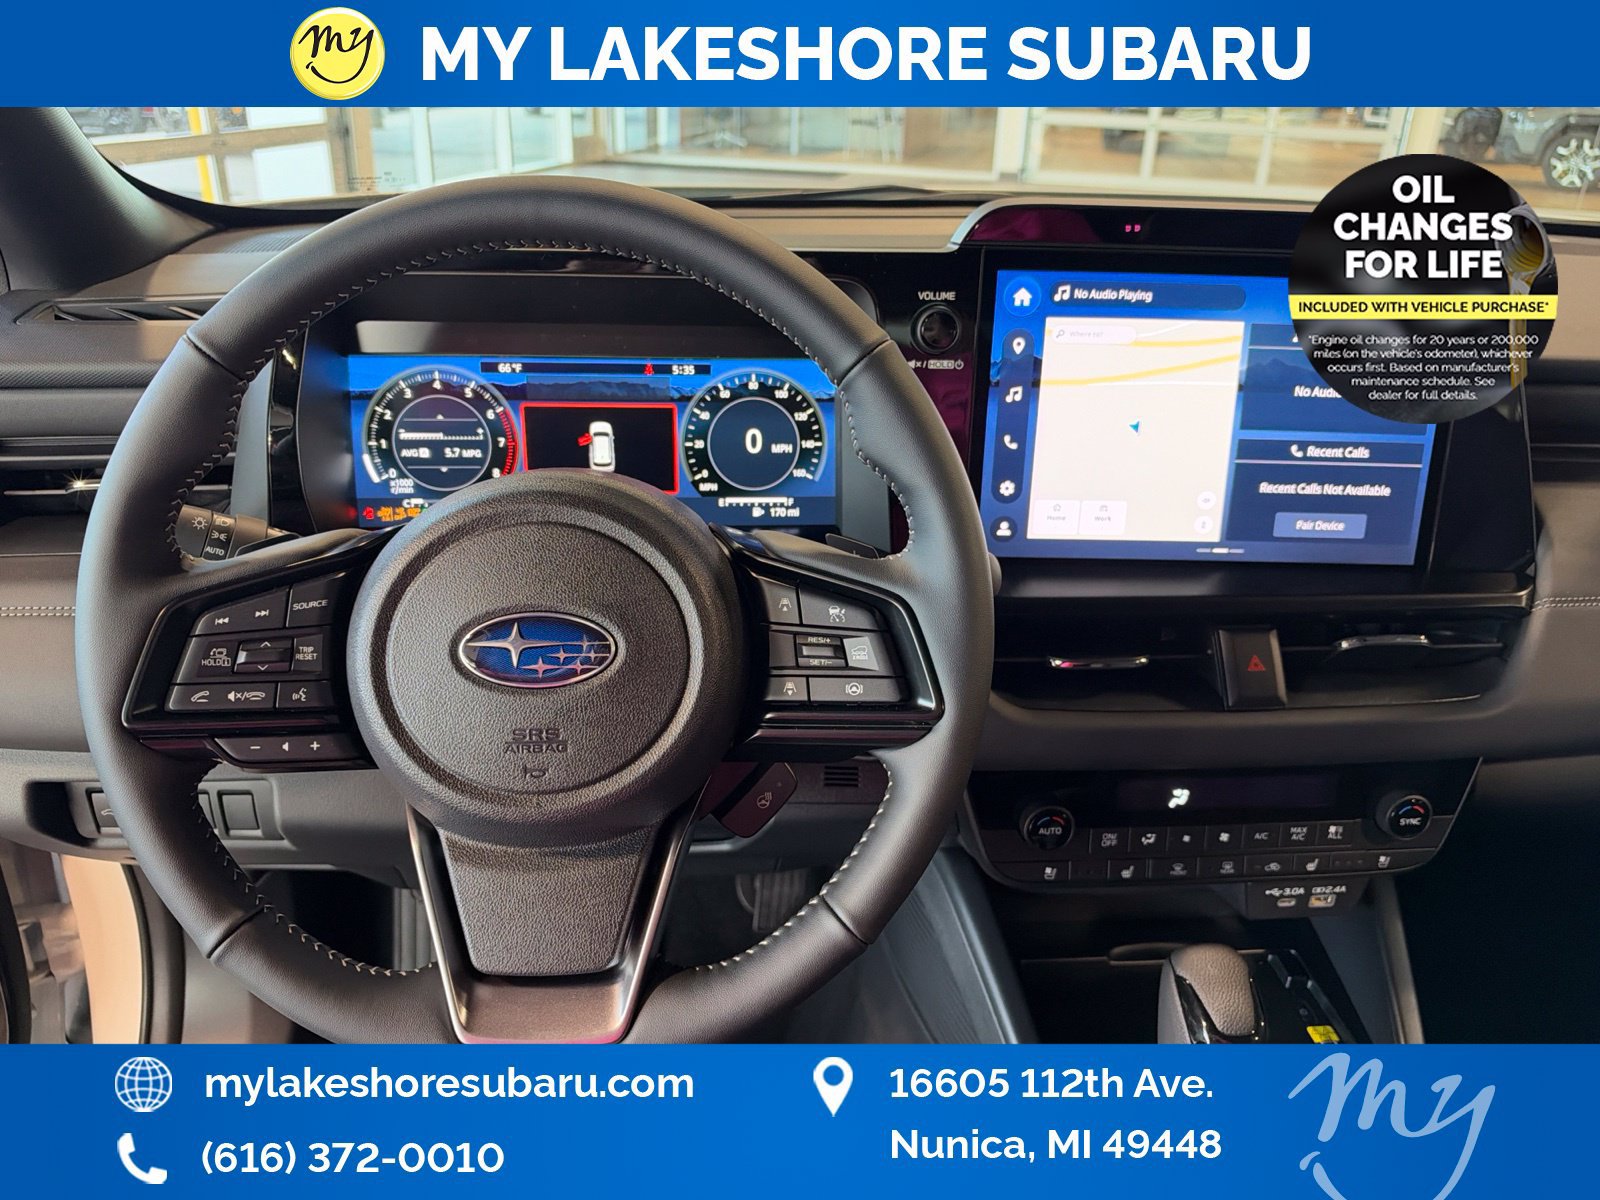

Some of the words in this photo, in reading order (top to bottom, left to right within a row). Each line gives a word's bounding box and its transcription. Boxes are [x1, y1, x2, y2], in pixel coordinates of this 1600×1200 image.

[917, 291, 957, 301] VOLUME
[1073, 288, 1088, 300] No
[1089, 289, 1117, 300] Audio
[1118, 289, 1153, 303] Playing
[672, 365, 695, 375] 5:35
[432, 380, 442, 390] 4
[748, 382, 759, 390] 80
[403, 388, 412, 399] 3
[464, 388, 472, 398] 5
[719, 390, 730, 399] 60
[774, 390, 788, 399] 100
[1293, 385, 1310, 397] No
[383, 410, 393, 420] 2
[486, 410, 495, 420] 6
[700, 411, 710, 420] 40
[794, 412, 808, 421] 120
[380, 439, 387, 449] 1
[497, 437, 505, 447] 7
[693, 440, 705, 449] 20
[745, 428, 763, 454] 0
[771, 444, 793, 454] MPH
[401, 449, 418, 458] AVG
[444, 448, 460, 458] 5.7
[462, 449, 482, 458] MPG
[1306, 445, 1344, 458] Recent
[1344, 446, 1370, 459] Calls
[388, 468, 397, 478] 0
[698, 482, 718, 492] MPH
[1258, 482, 1297, 494] Recent
[1297, 482, 1322, 495] Calls
[1323, 483, 1344, 496] Not
[1344, 484, 1392, 497] Available
[770, 508, 786, 517] 170
[787, 508, 800, 517] mi
[1295, 520, 1314, 531] Pair
[1314, 520, 1345, 531] Device
[205, 546, 224, 556] AUTO
[292, 599, 328, 610] SOURCE
[298, 646, 314, 654] TRIP
[295, 653, 318, 661] RESET
[201, 658, 222, 667] HOLD
[512, 728, 560, 741] SRS
[504, 743, 569, 754] AIRBAG
[1399, 818, 1422, 826] SYNC
[1038, 827, 1062, 835] AUTO
[1290, 826, 1308, 834] MAX
[1254, 832, 1270, 840] A/C
[1291, 833, 1306, 841] A/C
[1328, 832, 1343, 840] ALL
